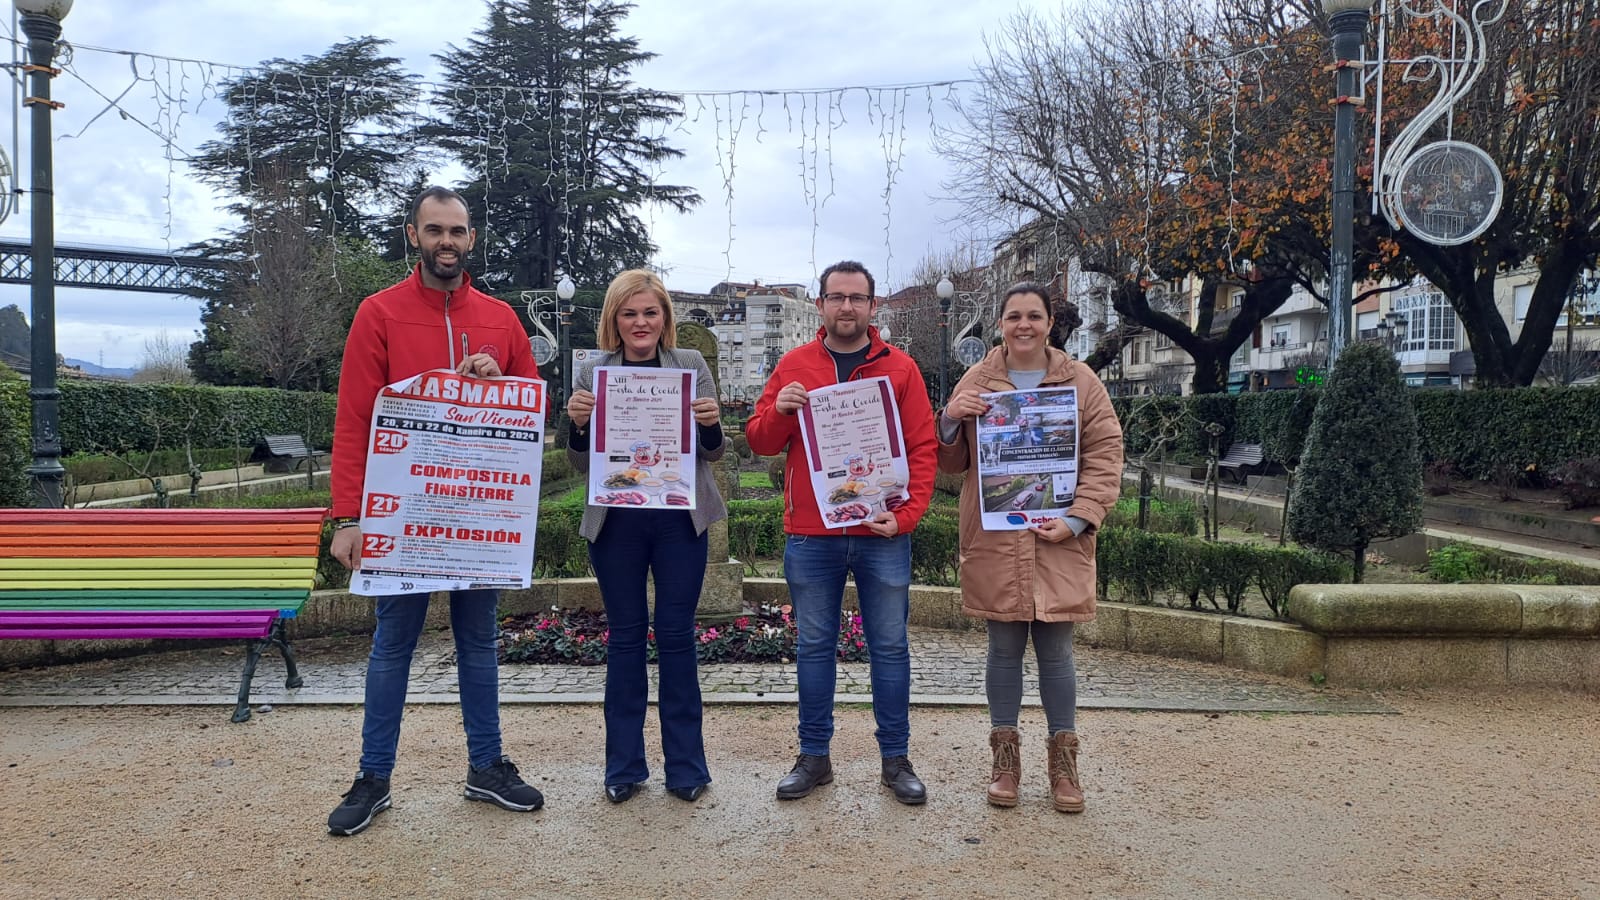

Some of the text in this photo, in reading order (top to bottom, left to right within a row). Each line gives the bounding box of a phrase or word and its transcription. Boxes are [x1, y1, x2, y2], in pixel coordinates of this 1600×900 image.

[391, 375, 537, 409] RASMAÑÓ
[608, 383, 633, 398] Festa
[444, 406, 537, 428] San Vicente
[812, 403, 837, 416] Festa
[382, 418, 399, 428] 20,
[402, 420, 414, 428] 21
[426, 422, 440, 430] 22
[456, 426, 492, 437] Xaneiro
[509, 431, 535, 441] 2024
[377, 432, 404, 448] 20
[410, 464, 532, 486] COMPOSTELA
[425, 482, 515, 501] FINISTERRE
[371, 496, 393, 512] 21
[365, 536, 394, 551] 22
[403, 524, 522, 544] EXPLOSIÓN
